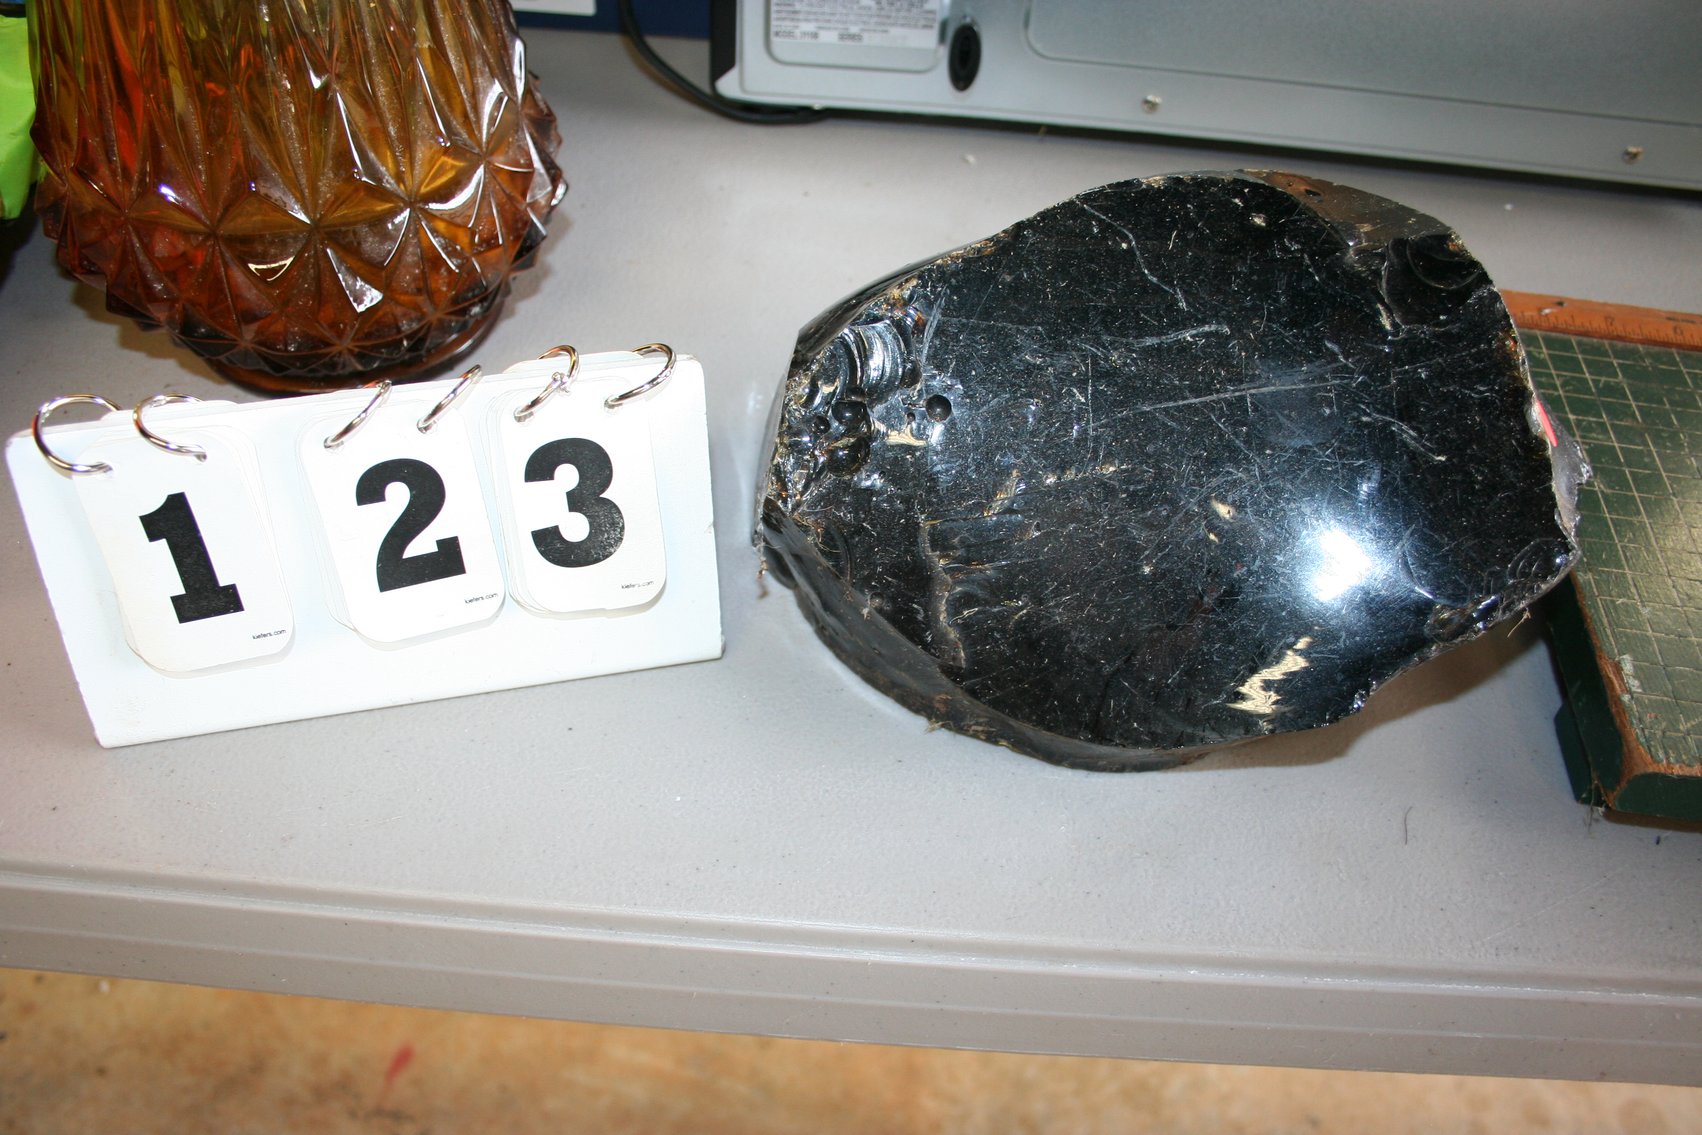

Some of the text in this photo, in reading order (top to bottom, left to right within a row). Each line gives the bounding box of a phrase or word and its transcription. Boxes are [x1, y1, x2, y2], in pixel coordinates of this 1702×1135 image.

[139, 438, 624, 623] 1 2 3
